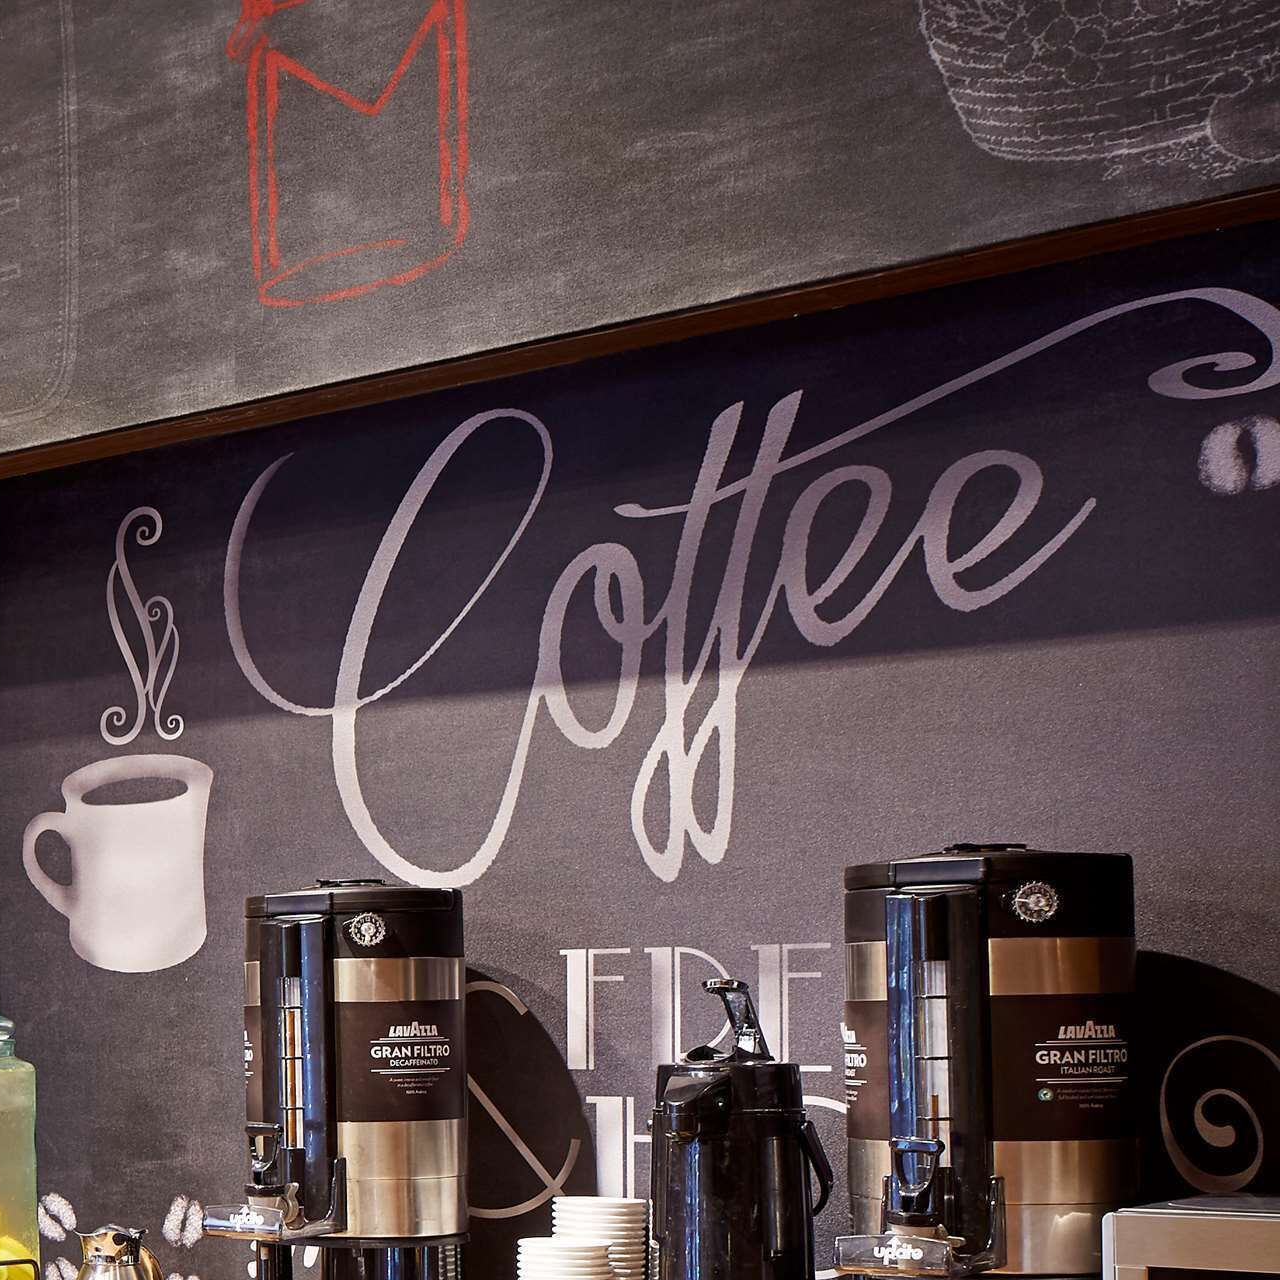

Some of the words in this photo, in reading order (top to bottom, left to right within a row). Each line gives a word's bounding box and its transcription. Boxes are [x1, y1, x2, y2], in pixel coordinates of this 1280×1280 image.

[225, 340, 1100, 890] Coffee
[388, 1021, 438, 1038] LAVAZZA
[1058, 1020, 1116, 1039] LAVAZZA
[370, 1046, 411, 1058] GRAN
[414, 1045, 450, 1057] FILTRO
[1035, 1050, 1086, 1064] GRAN
[1088, 1049, 1128, 1063] FILTRO
[390, 1059, 438, 1067] DECAFFEINATO
[1060, 1066, 1092, 1074] ITALIAN
[1094, 1065, 1115, 1073] ROAST
